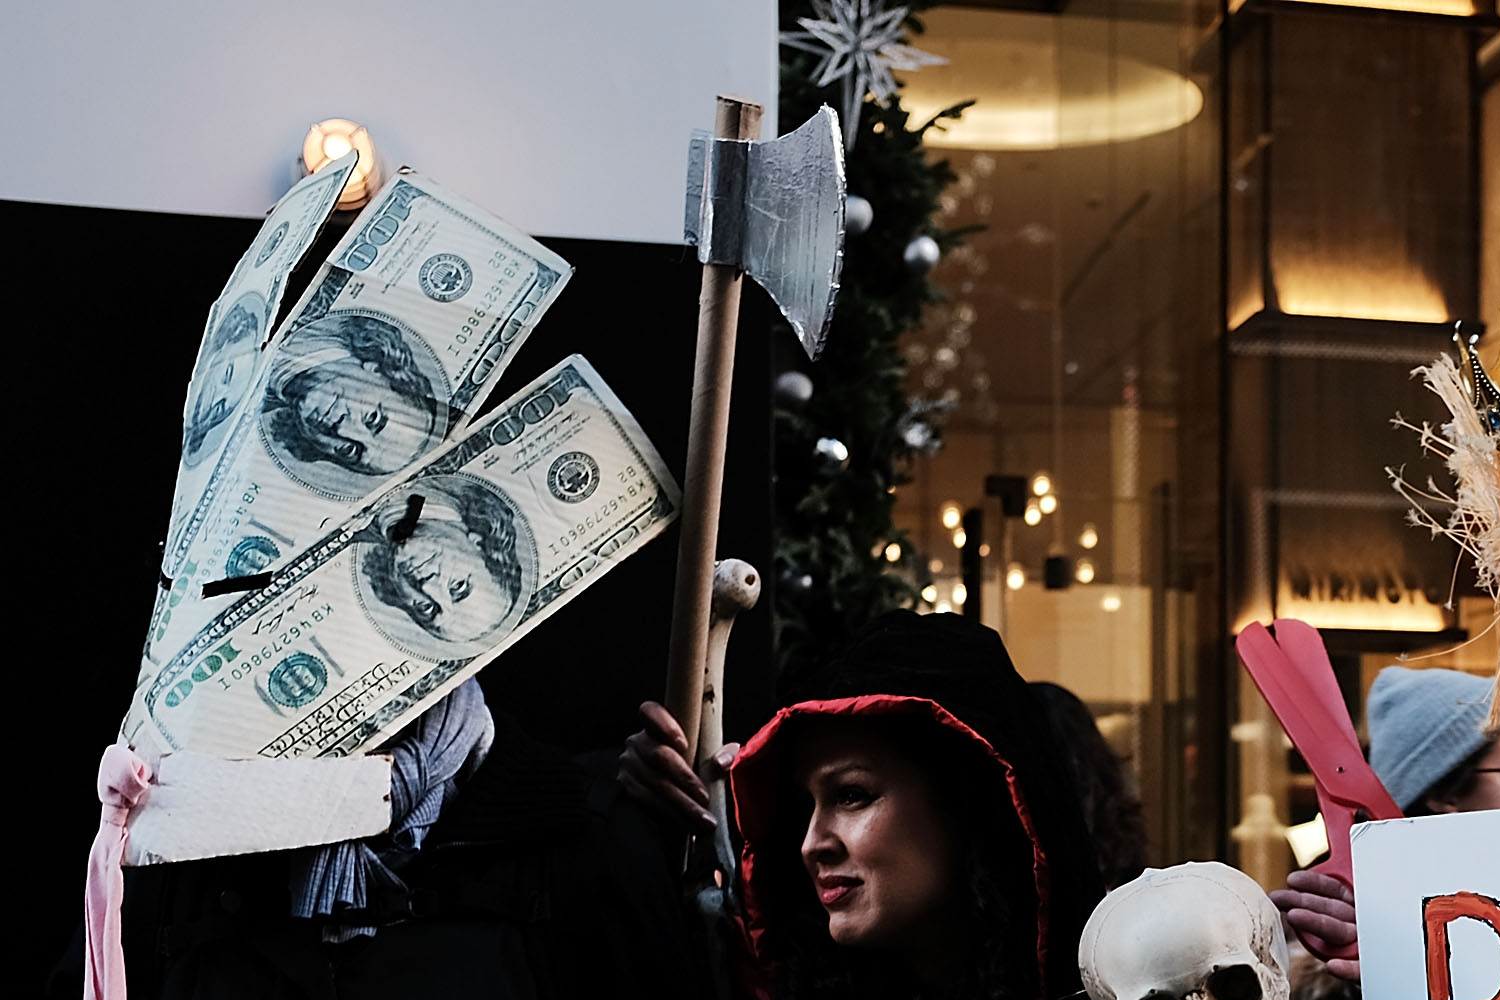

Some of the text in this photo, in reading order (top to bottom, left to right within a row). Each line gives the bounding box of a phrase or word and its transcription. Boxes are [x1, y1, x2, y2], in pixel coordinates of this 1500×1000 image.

[345, 194, 410, 272] 100
[491, 377, 571, 444] 100
[313, 530, 352, 561] ONE
[221, 555, 315, 626] HUNDRED
[163, 638, 241, 707] 100
